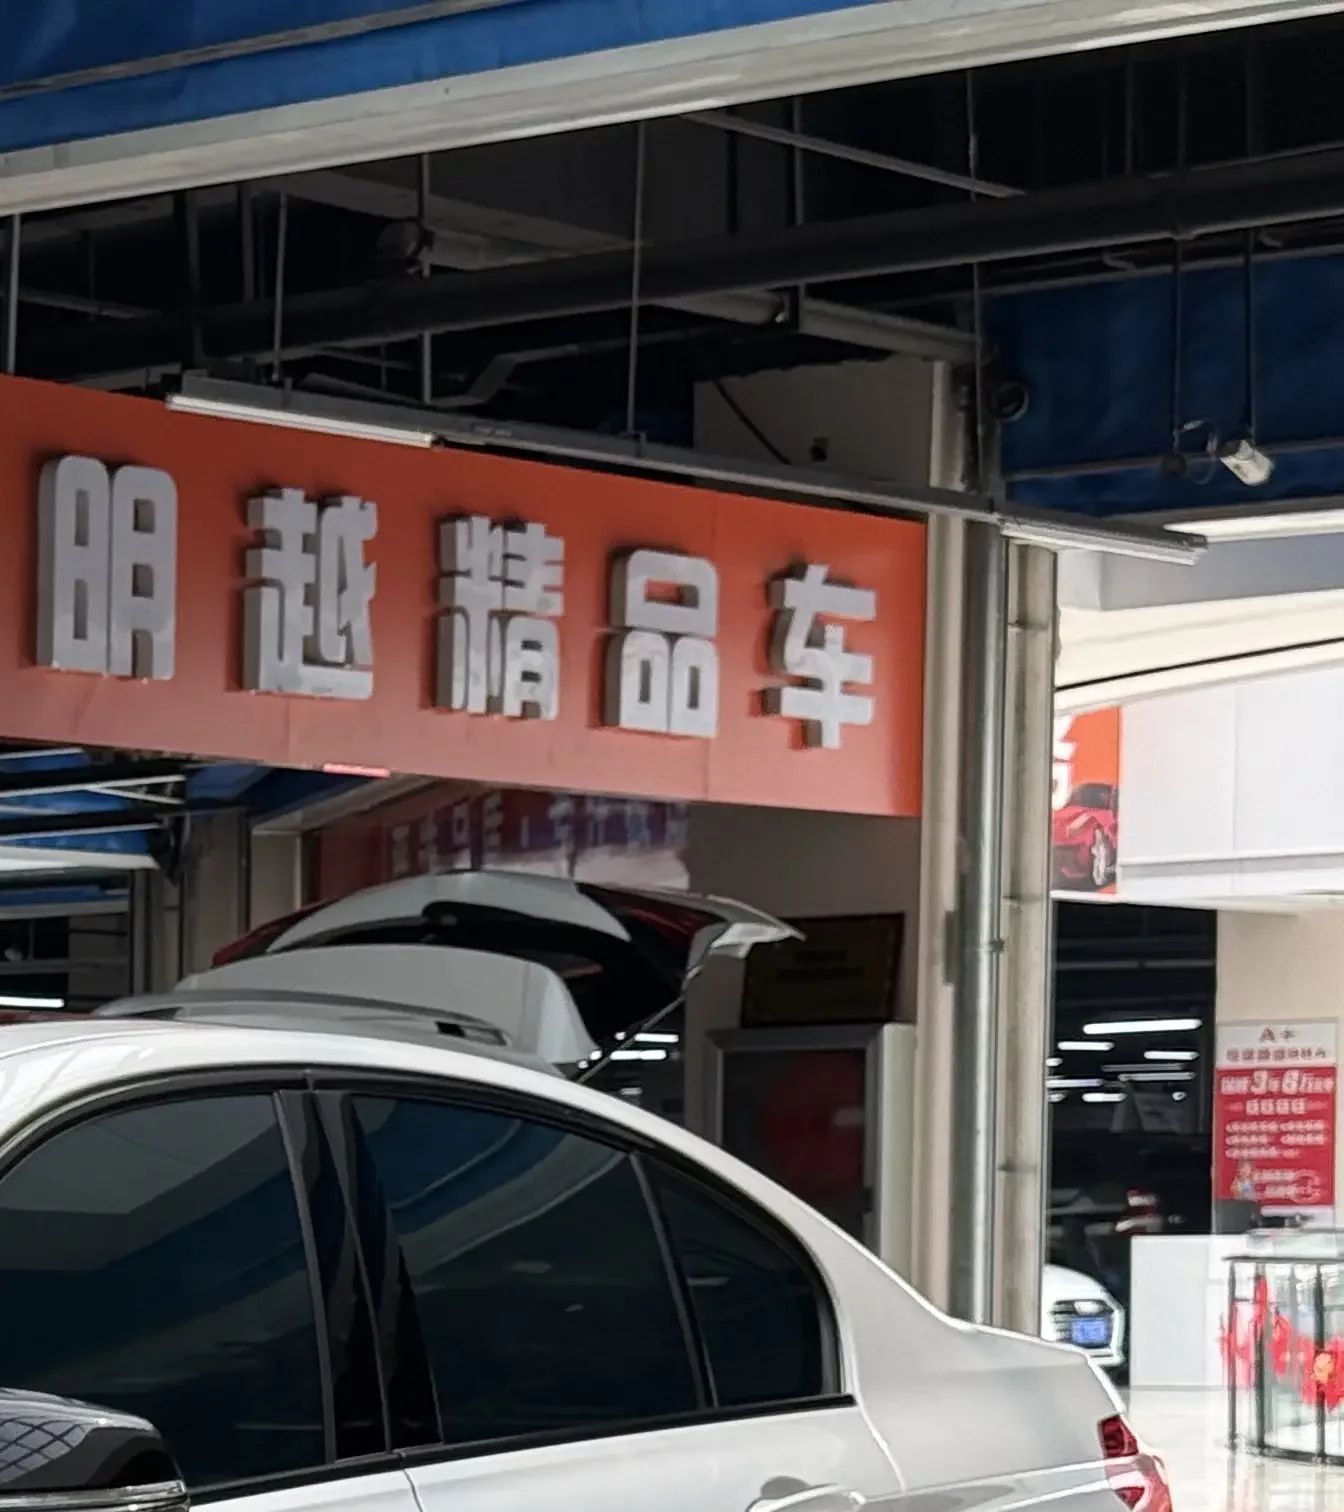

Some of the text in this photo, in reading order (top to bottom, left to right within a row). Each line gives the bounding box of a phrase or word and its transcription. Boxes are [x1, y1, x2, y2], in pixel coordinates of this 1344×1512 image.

[35, 454, 878, 749] 明越精品车
